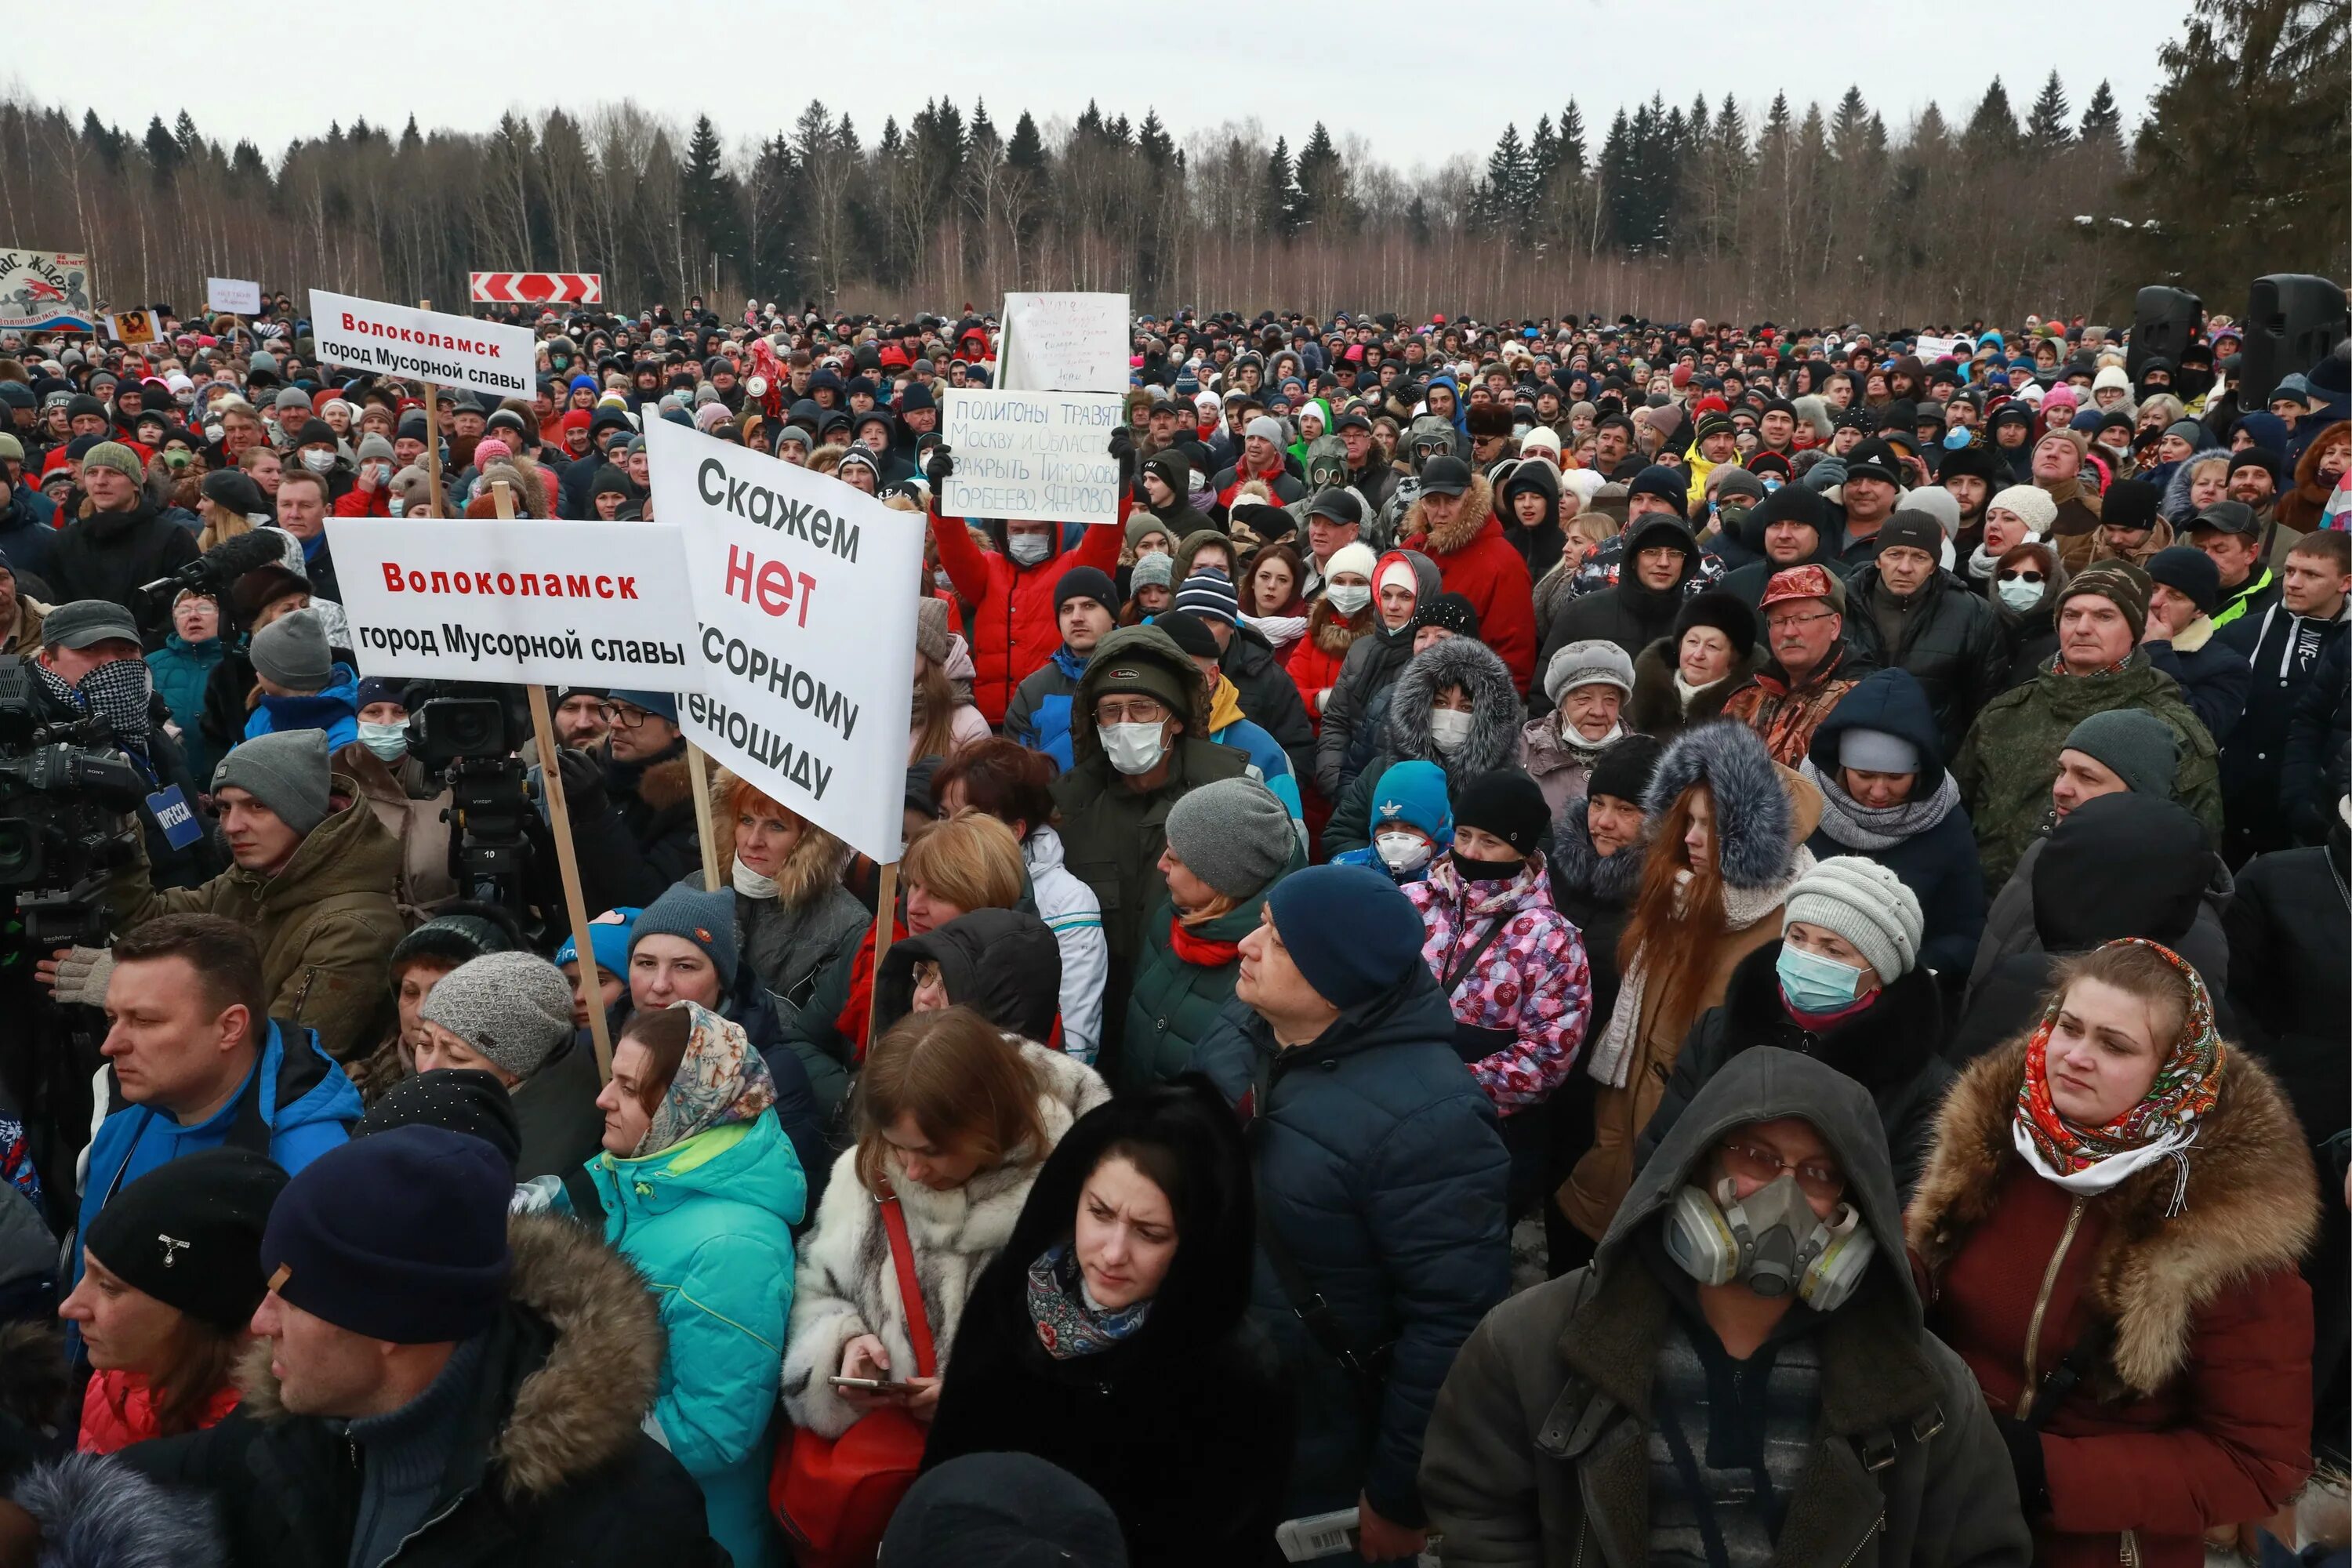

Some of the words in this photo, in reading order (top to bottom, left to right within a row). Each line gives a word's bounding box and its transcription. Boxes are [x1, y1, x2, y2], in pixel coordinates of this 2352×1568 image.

[342, 313, 500, 358] Волоколамск
[322, 341, 372, 365] город
[376, 347, 463, 379] Мусорной
[468, 368, 525, 390] славы
[956, 401, 1048, 423] ПОЛИГОНЫ
[1061, 404, 1123, 426] ТРАВЯТ
[952, 456, 1029, 480] ЗАКРЫТЬ
[698, 458, 859, 564] Скажем
[382, 562, 639, 600] Волоколамск
[359, 626, 440, 657] город
[441, 623, 583, 664] Мусорной
[592, 637, 686, 666] славы
[2298, 628, 2321, 658] NIKE
[157, 801, 192, 829] ПРЕССА
[484, 850, 495, 858] 10
